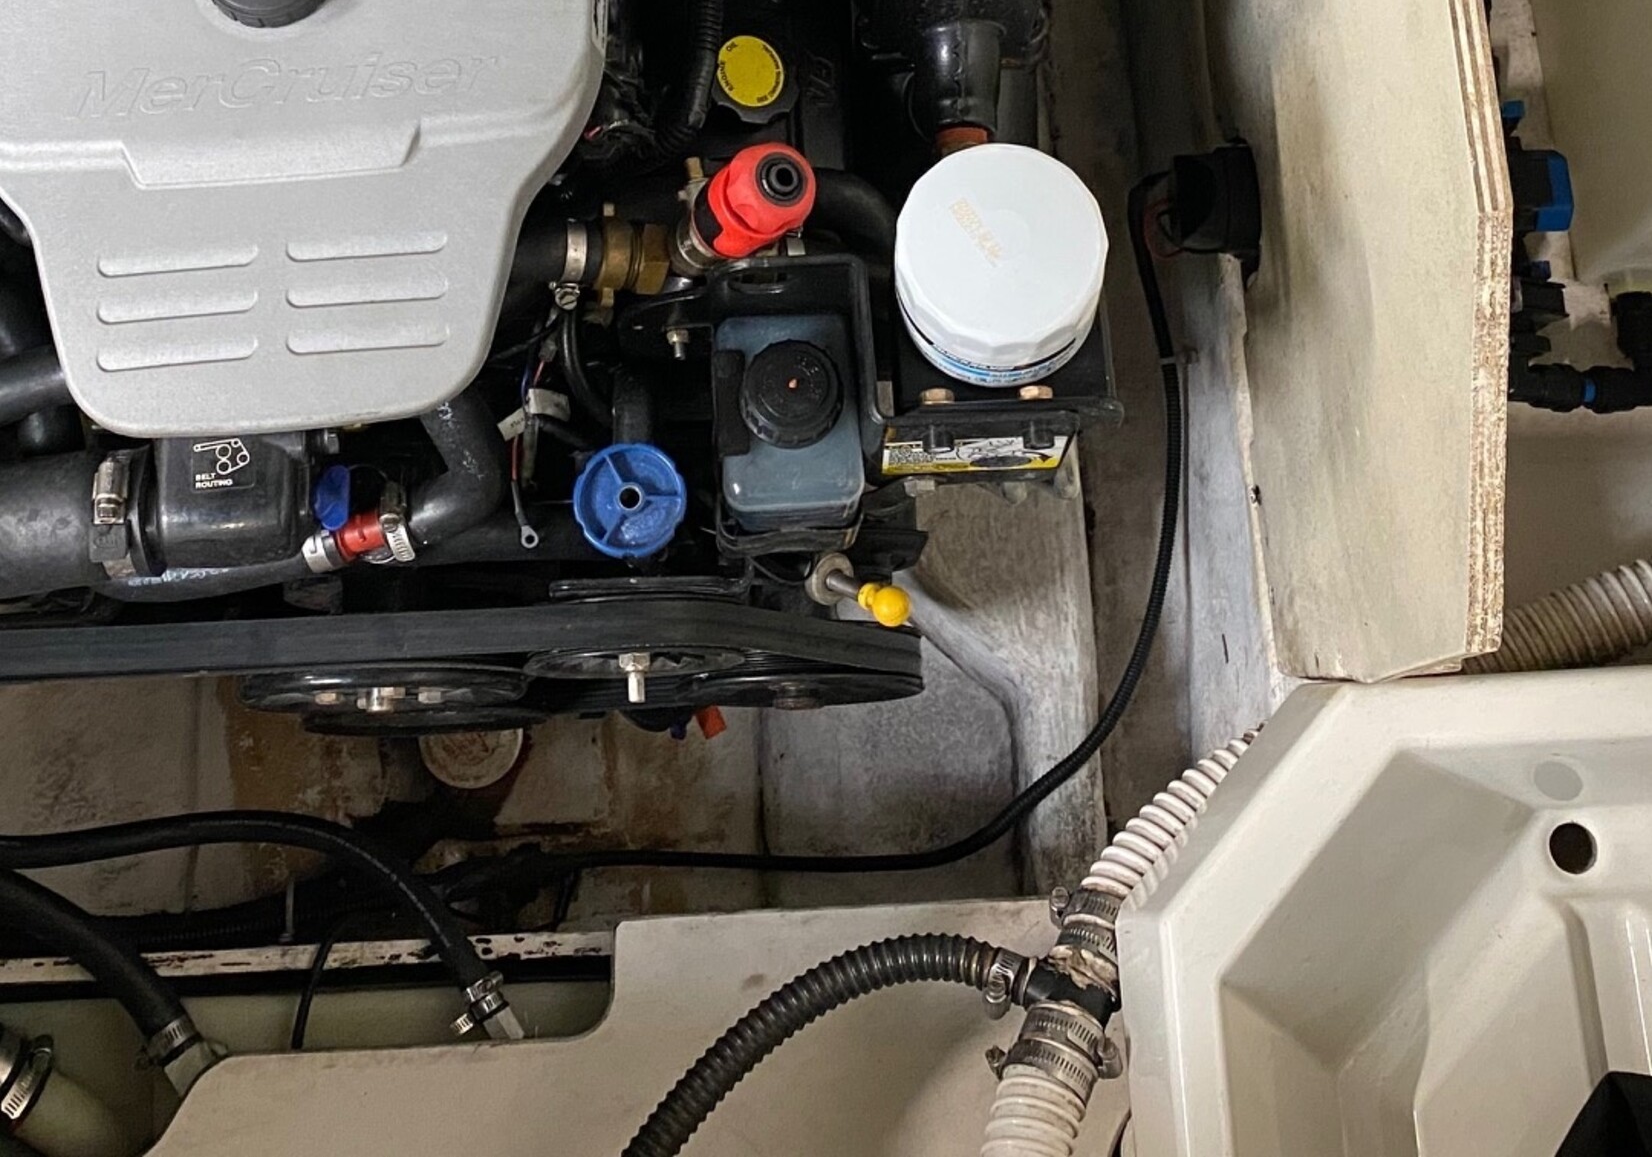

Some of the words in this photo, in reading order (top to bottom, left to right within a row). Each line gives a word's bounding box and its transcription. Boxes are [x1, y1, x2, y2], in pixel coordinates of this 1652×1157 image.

[66, 51, 498, 120] MerCruiser
[195, 472, 215, 481] BELT
[195, 479, 233, 489] ROUTING
